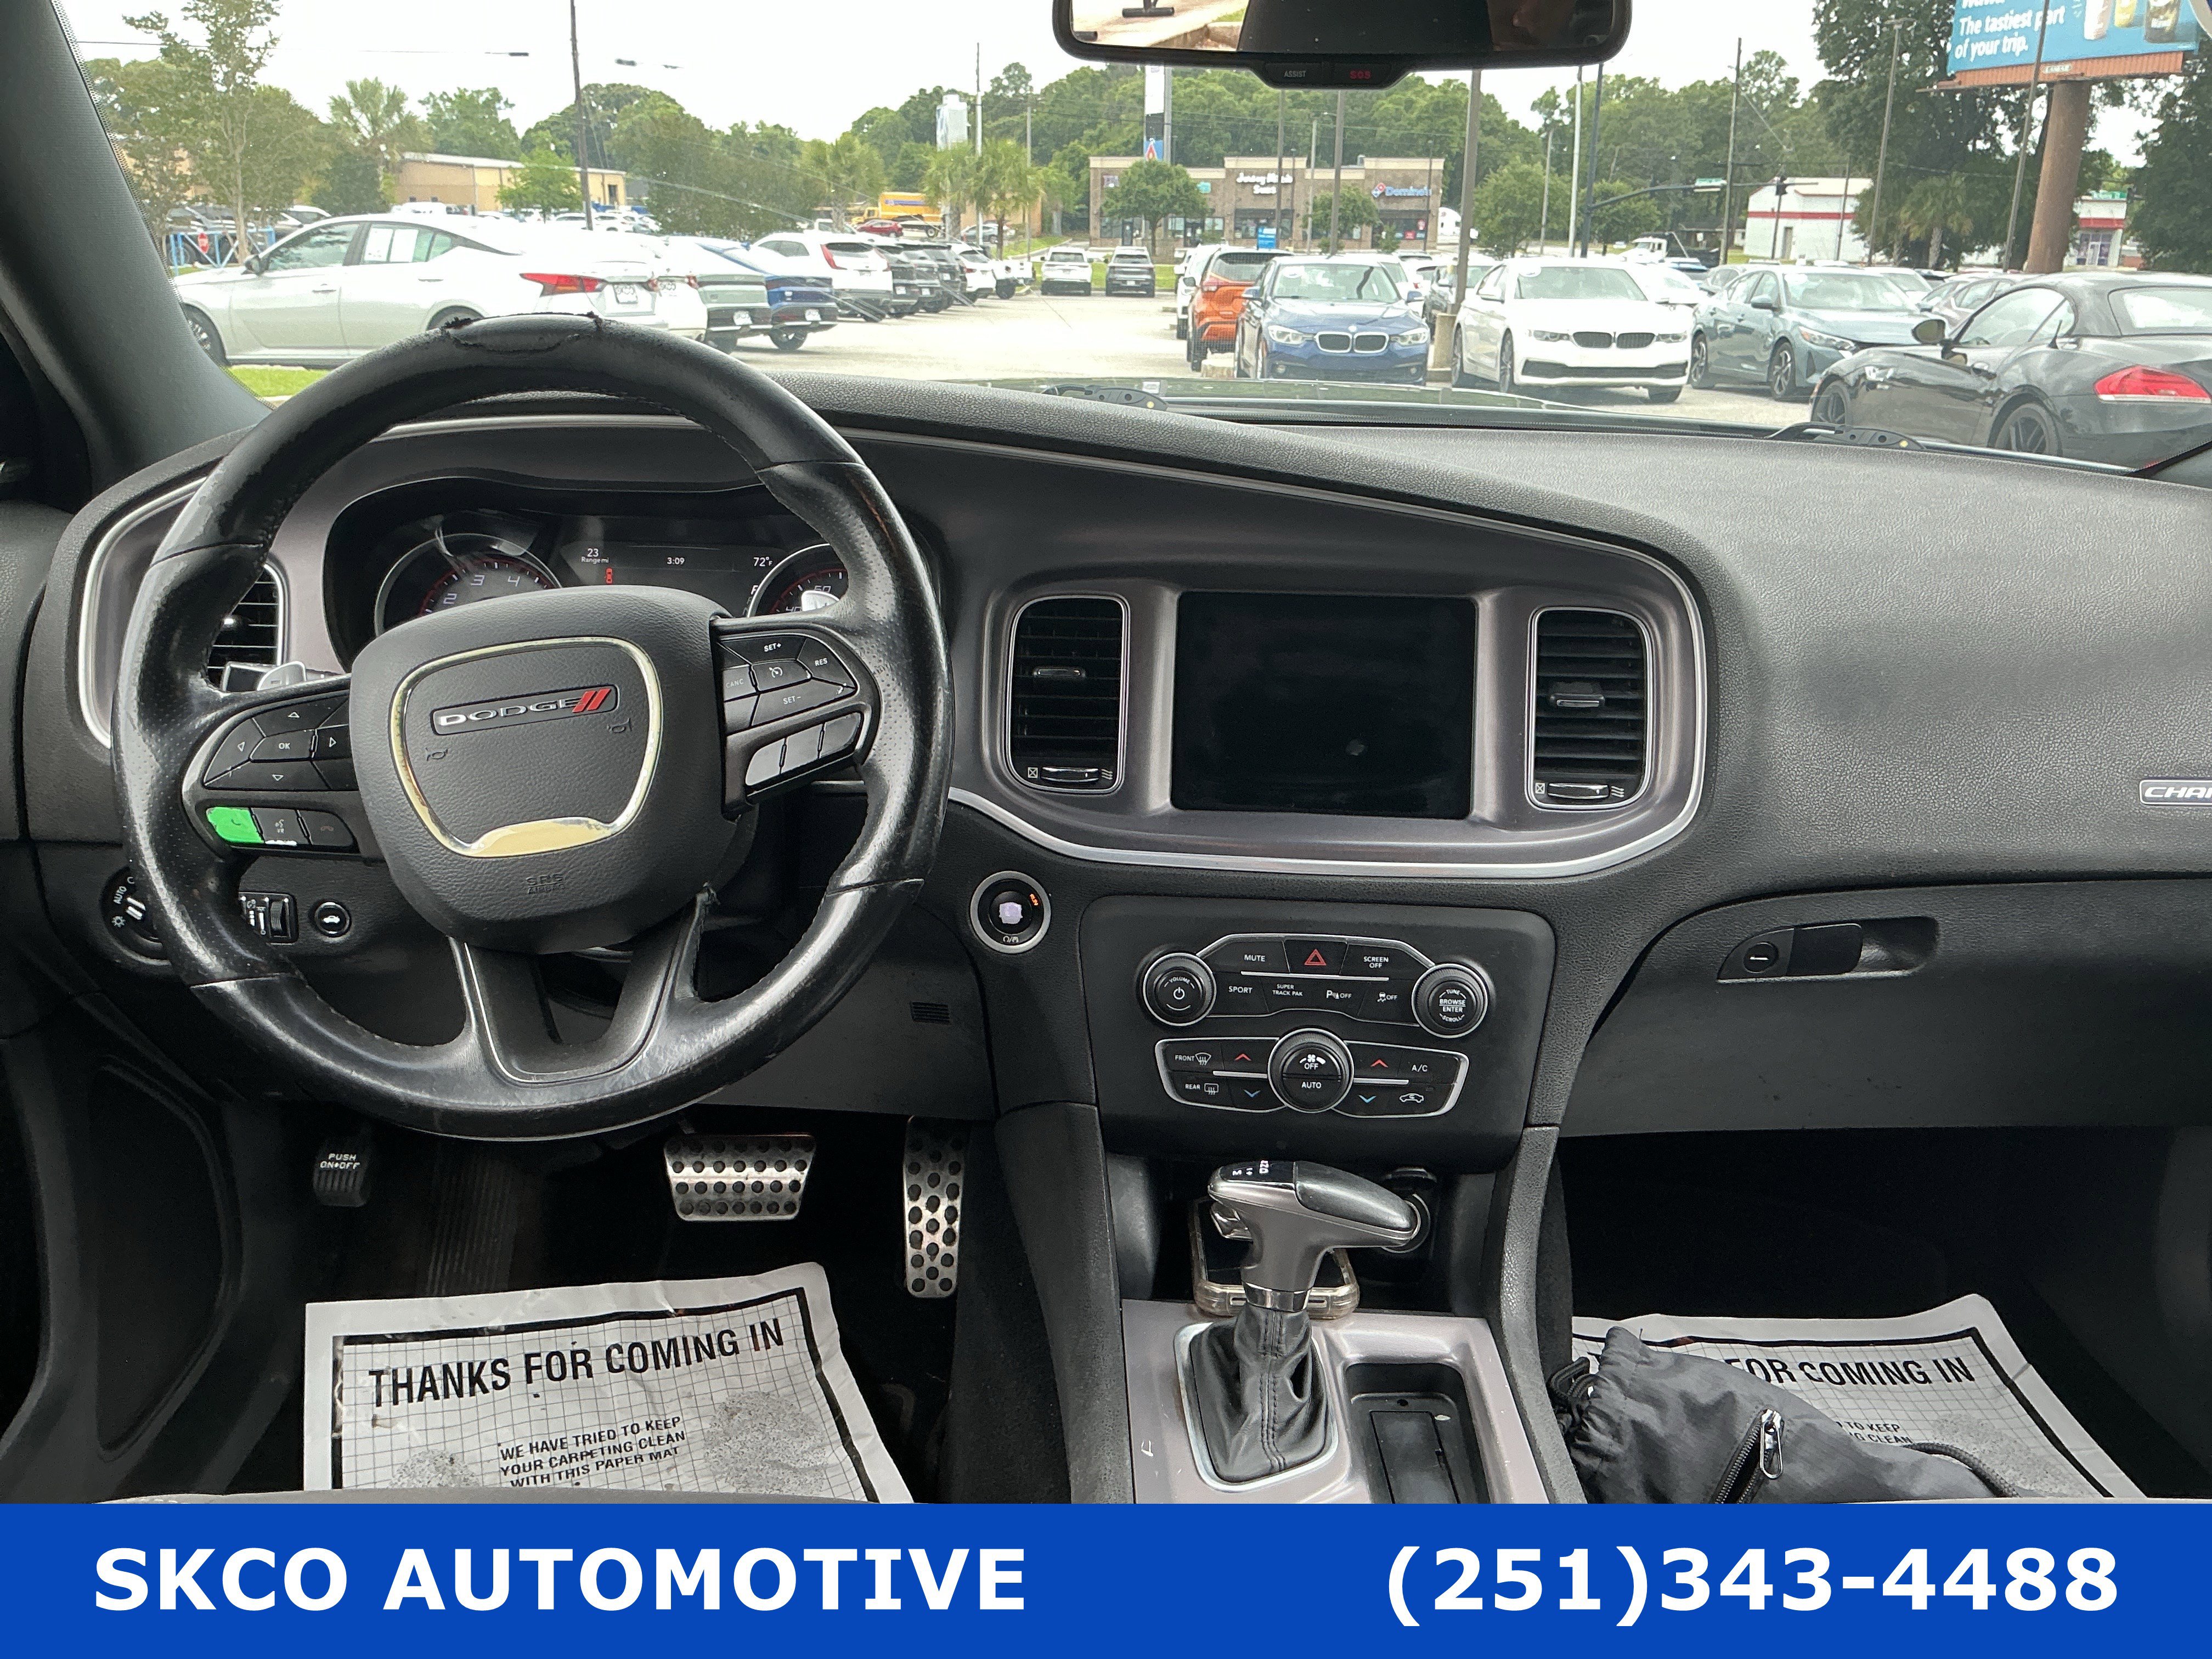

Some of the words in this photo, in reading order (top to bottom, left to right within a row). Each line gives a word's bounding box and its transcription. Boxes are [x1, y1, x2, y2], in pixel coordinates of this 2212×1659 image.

[1960, 15, 1982, 36] The
[1985, 9, 2033, 33] tastiest
[2034, 5, 2066, 31] part
[1955, 38, 1970, 59] of
[1971, 40, 2001, 62] your
[1350, 70, 1371, 80] SOS
[587, 548, 599, 557] 23
[581, 556, 601, 565] Range
[470, 574, 485, 586] 3
[507, 575, 521, 587] 4
[443, 593, 458, 605] 2
[815, 657, 828, 667] RES
[726, 678, 744, 688] CANC
[439, 697, 583, 726] DODGE
[113, 885, 127, 905] AUTO
[1169, 977, 1190, 985] VOLUME
[1411, 1064, 1428, 1073] A/C
[329, 1153, 357, 1161] PUSH
[369, 1358, 510, 1408] THANKS
[524, 1348, 594, 1385] FOR
[606, 1329, 740, 1374] COMING
[749, 1318, 784, 1352] IN
[1798, 1361, 1932, 1386] COMING
[1932, 1357, 1975, 1383] IN
[1844, 1421, 1865, 1430] TO
[1866, 1424, 1900, 1433] KEEP
[500, 1444, 525, 1462] WE
[529, 1437, 568, 1455] HAVE
[572, 1429, 617, 1447] TRIED
[621, 1423, 641, 1436] TO
[645, 1416, 681, 1431] KEEP
[1867, 1434, 1913, 1443] CLEAN
[500, 1459, 544, 1477] YOUR
[549, 1441, 634, 1469] CARPETING
[638, 1430, 686, 1450] CLEAN
[510, 1473, 550, 1488] WITH
[558, 1464, 591, 1482] THIS
[596, 1453, 644, 1471] PAPER
[650, 1446, 680, 1462] MAT
